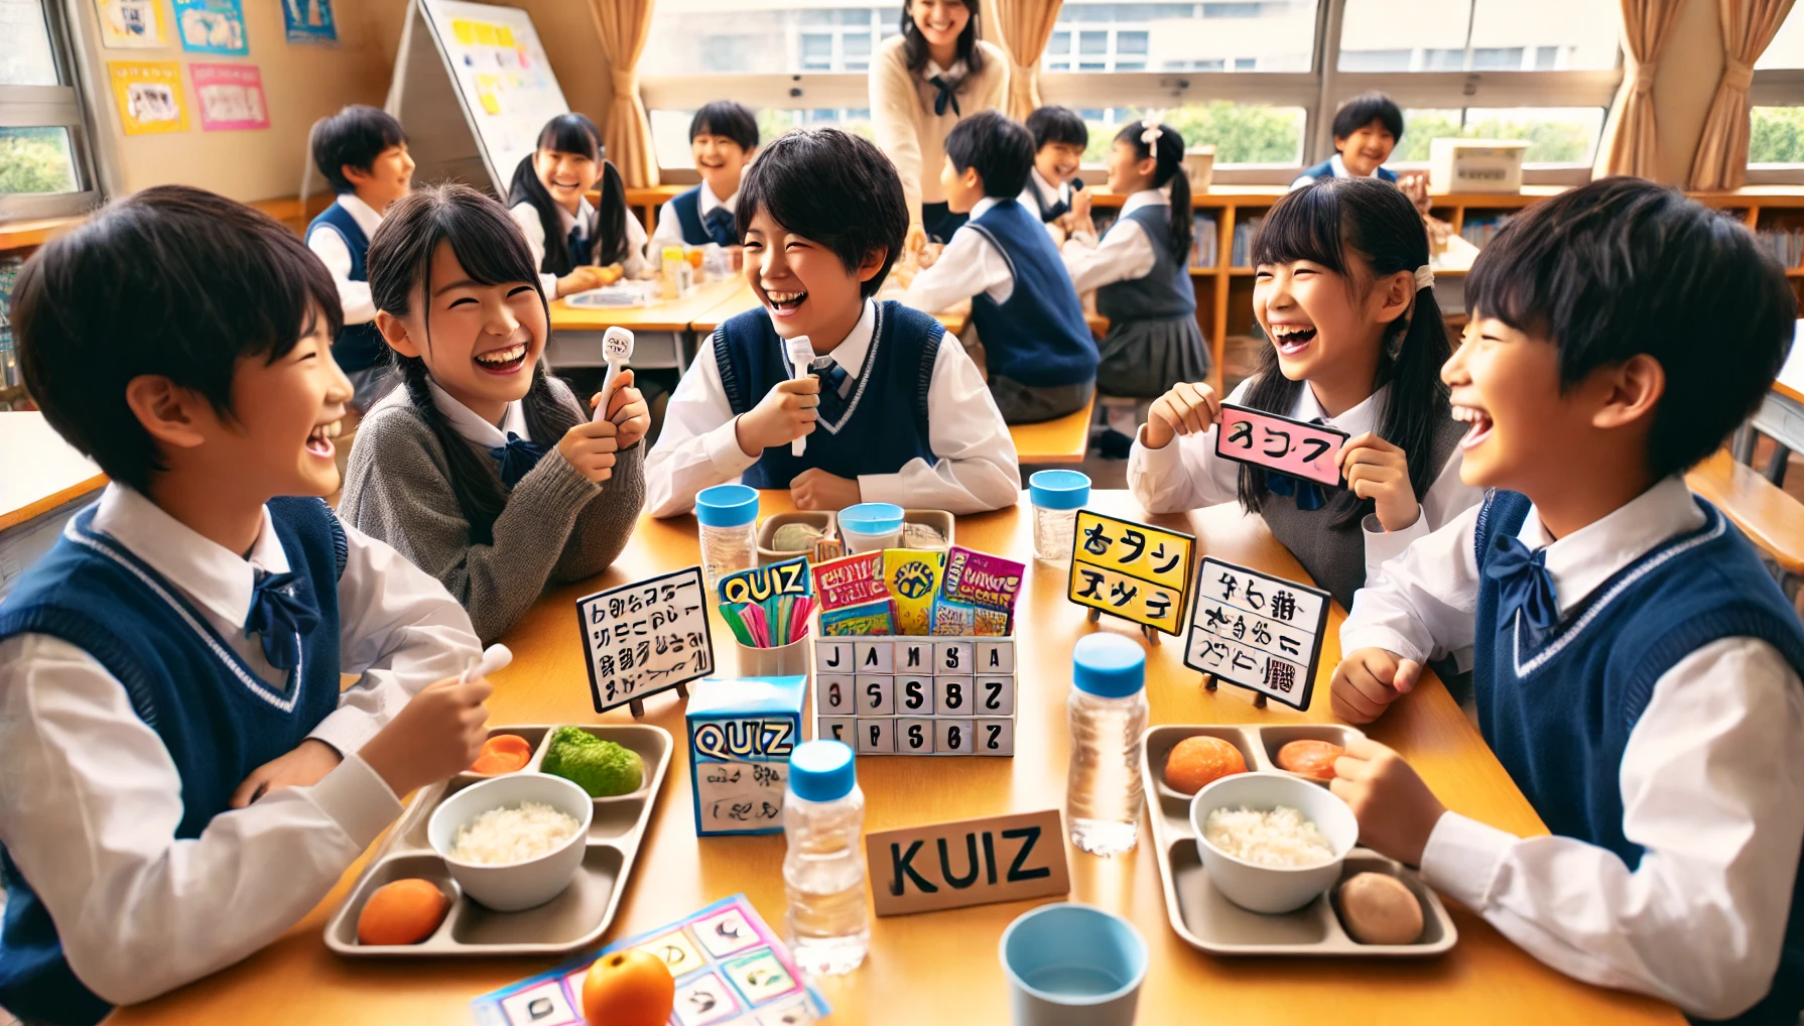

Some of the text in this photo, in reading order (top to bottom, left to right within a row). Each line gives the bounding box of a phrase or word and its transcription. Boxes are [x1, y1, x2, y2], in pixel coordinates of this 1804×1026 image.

[724, 561, 805, 604] QUIZ
[695, 720, 794, 762] QUIZ
[889, 826, 1051, 897] KUIZ
